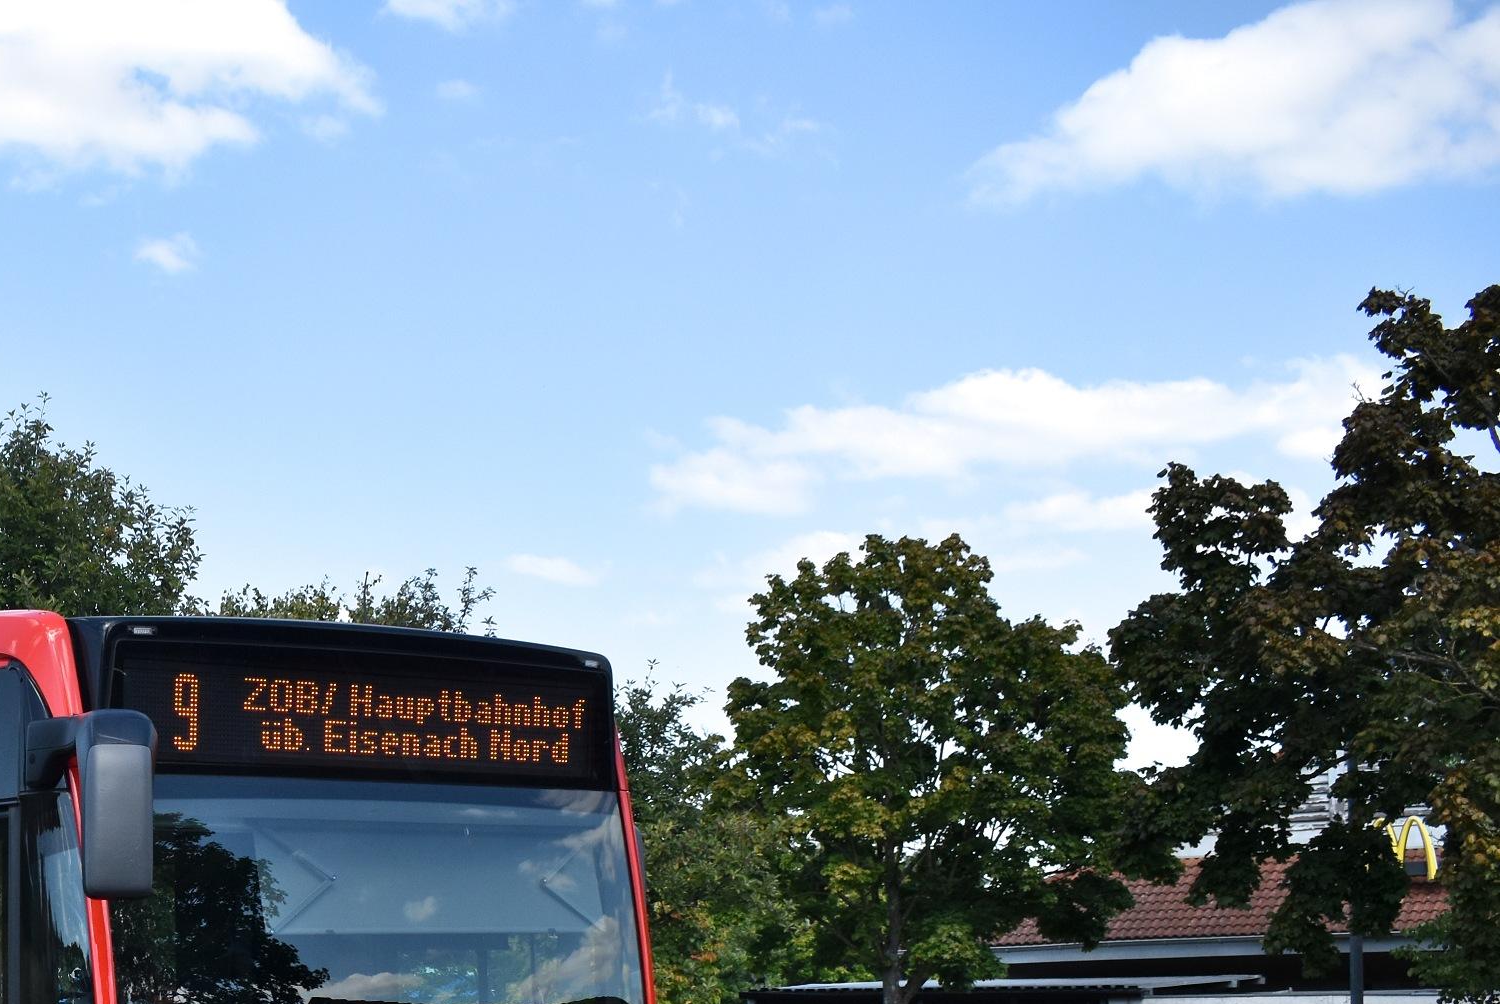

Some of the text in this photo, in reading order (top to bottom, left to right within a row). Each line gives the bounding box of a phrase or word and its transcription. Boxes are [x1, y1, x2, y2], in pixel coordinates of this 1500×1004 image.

[173, 673, 198, 751] 9
[243, 677, 585, 729] ZOB/ Hauptbahnhof
[262, 718, 568, 763] üb. Eisenach Nord
